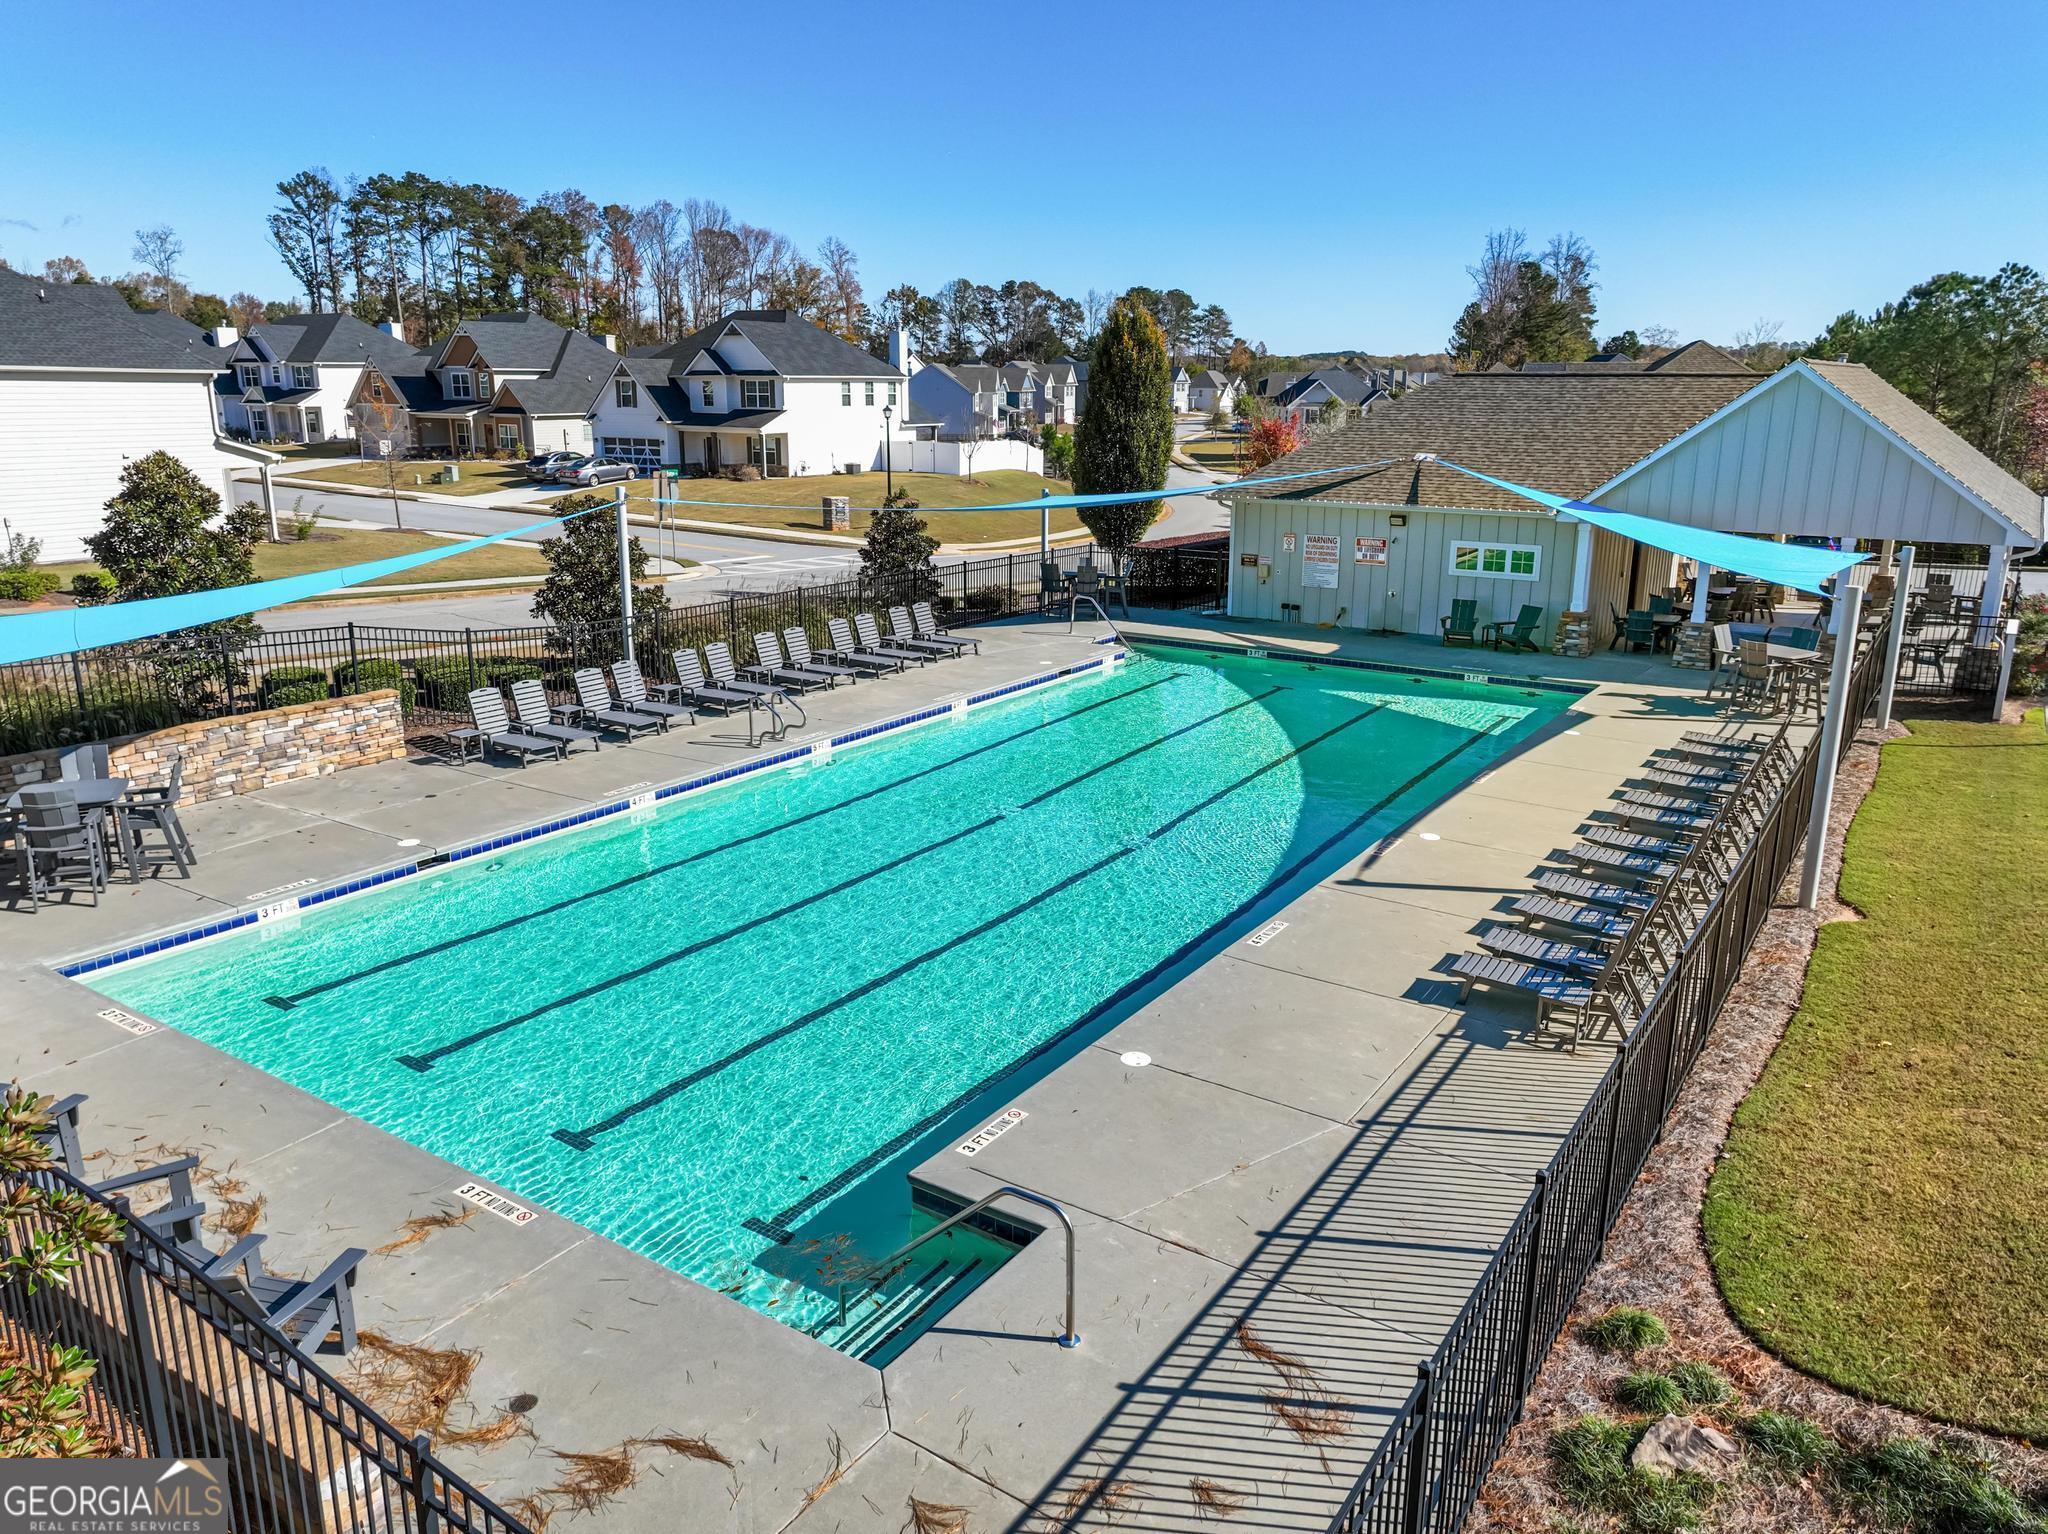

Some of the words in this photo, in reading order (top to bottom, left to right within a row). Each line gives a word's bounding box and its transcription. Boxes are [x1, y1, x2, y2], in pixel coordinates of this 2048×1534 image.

[1306, 535, 1338, 545] WARNING
[1360, 539, 1384, 547] WARNING
[638, 795, 646, 803] FT
[261, 908, 269, 918] 3
[272, 903, 284, 916] FT
[962, 1145, 976, 1153] 3
[971, 1134, 990, 1146] FT
[460, 1185, 476, 1195] 3
[470, 1190, 493, 1202] FT
